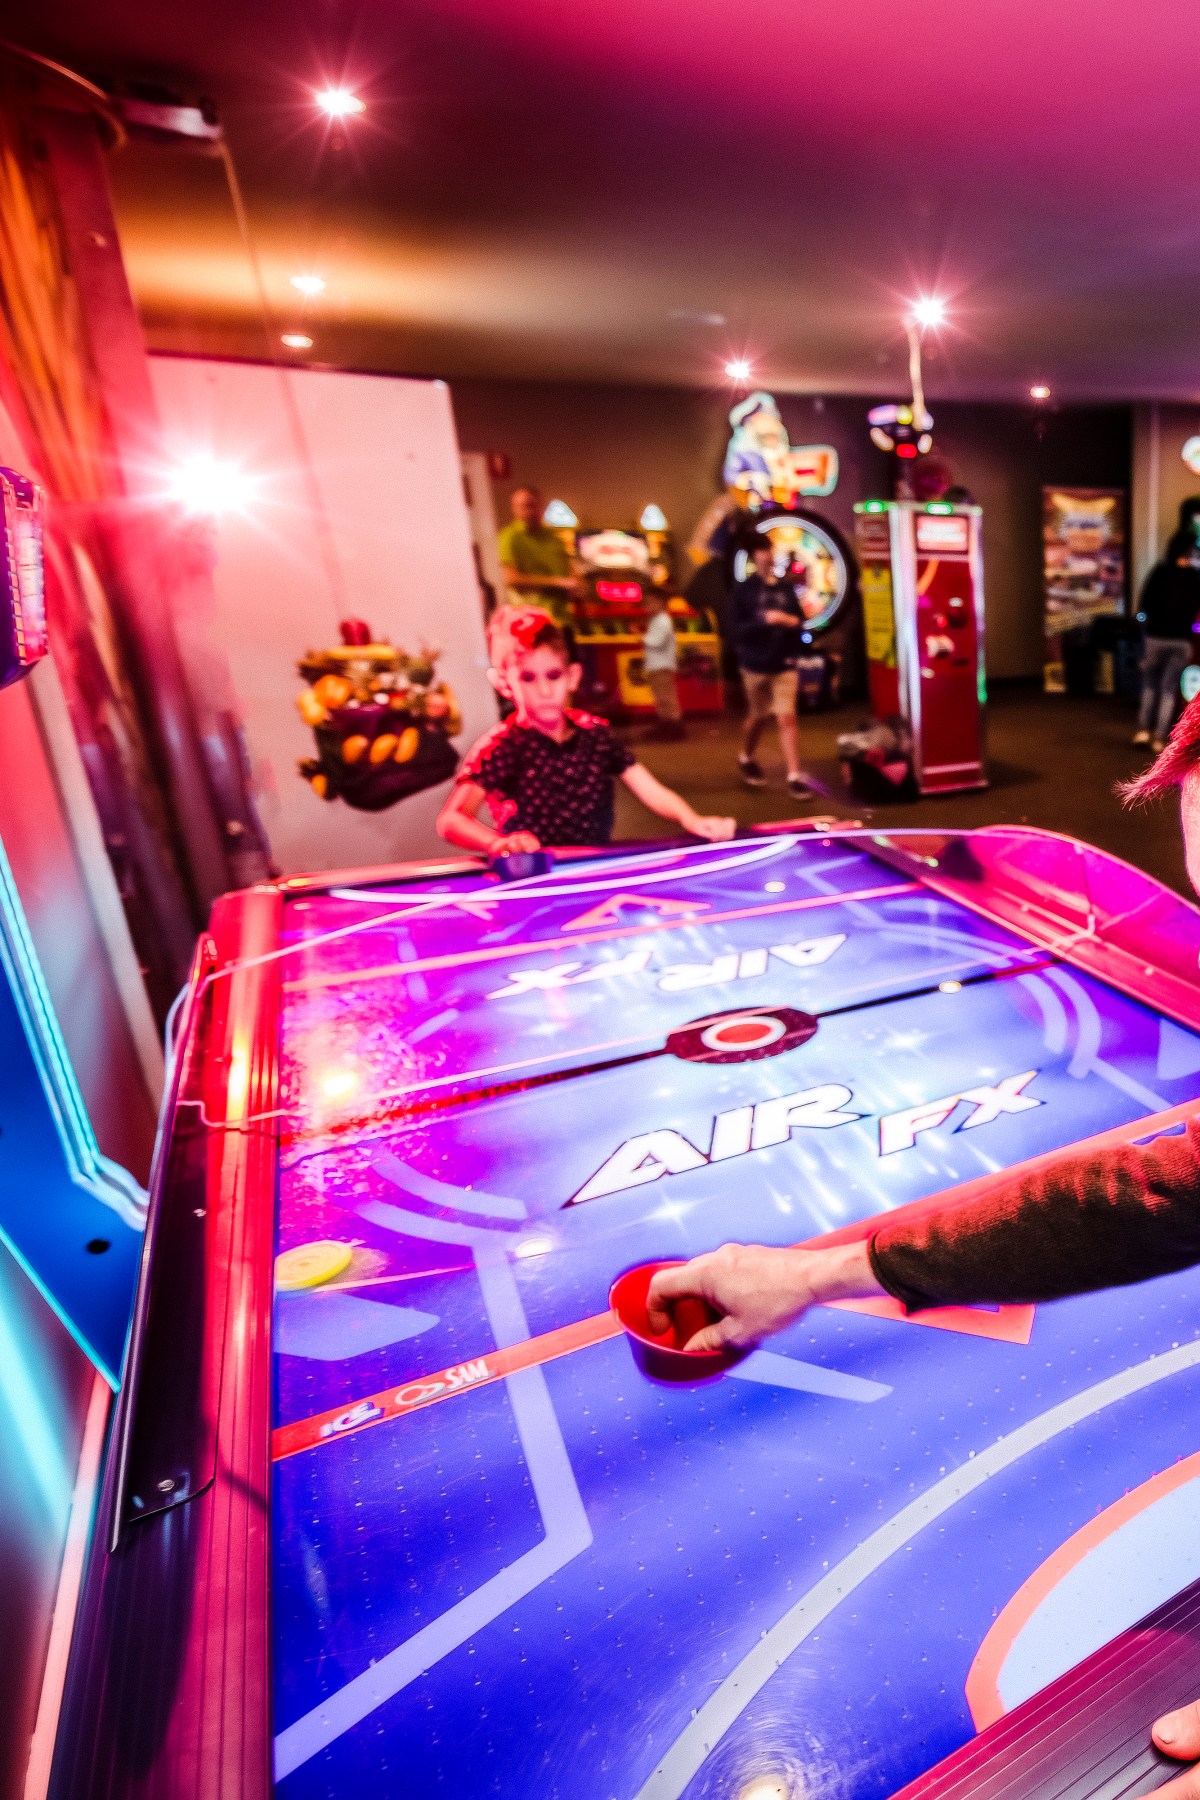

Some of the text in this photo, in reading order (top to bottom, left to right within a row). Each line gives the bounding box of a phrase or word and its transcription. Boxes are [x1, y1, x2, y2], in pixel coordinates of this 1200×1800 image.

[486, 934, 847, 1000] AIR FX
[561, 1069, 1045, 1209] AIR FX
[445, 1359, 489, 1388] SAM
[320, 1402, 385, 1437] ICE
